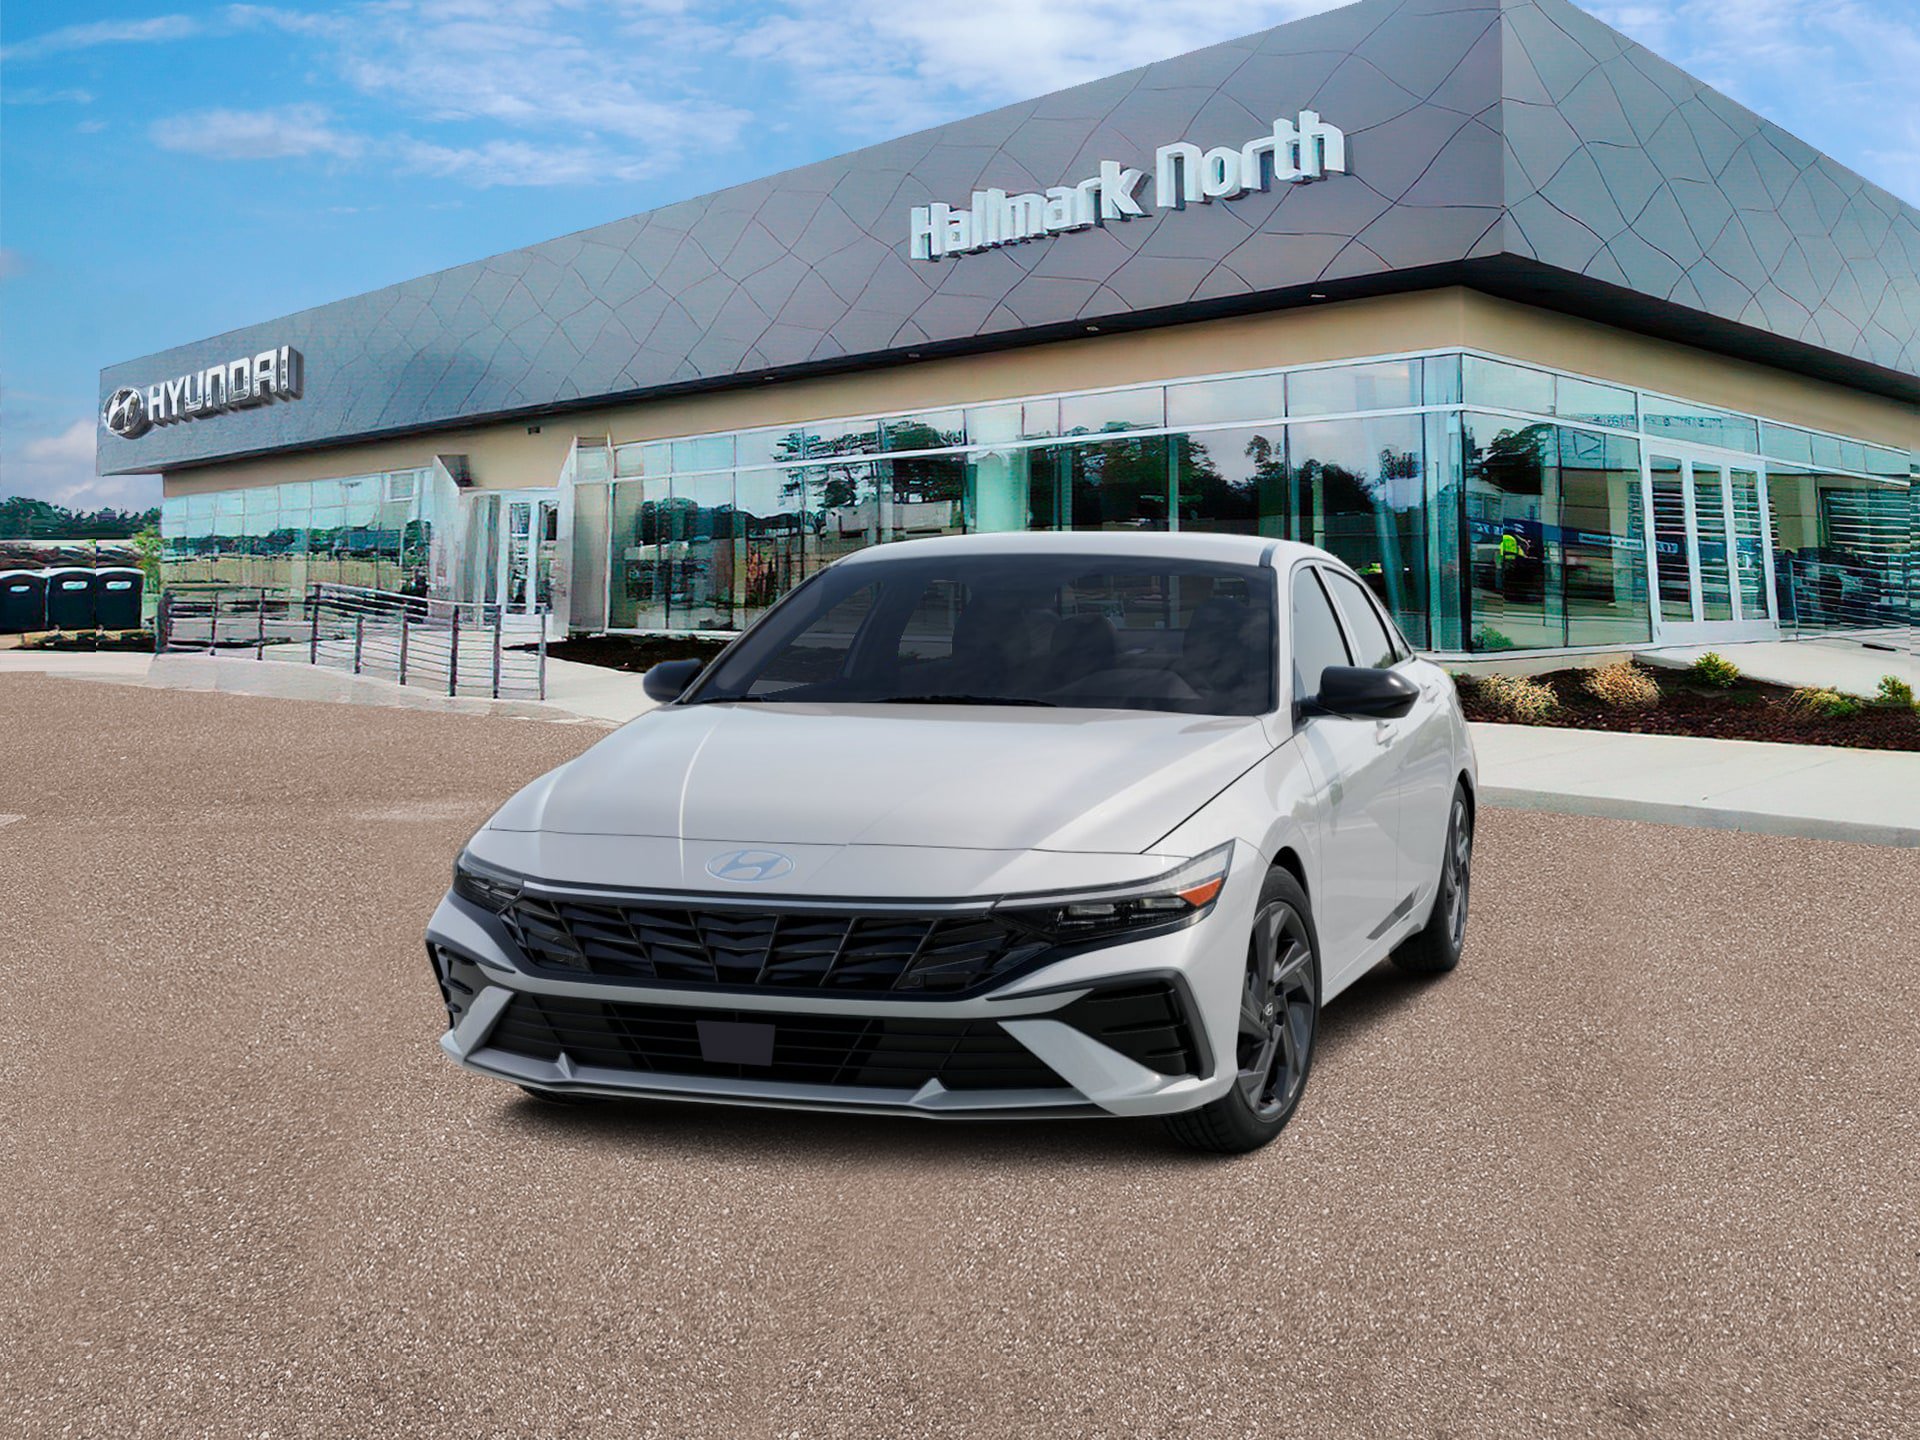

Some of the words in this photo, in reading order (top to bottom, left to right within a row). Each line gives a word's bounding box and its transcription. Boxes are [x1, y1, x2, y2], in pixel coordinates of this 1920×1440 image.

[911, 160, 1144, 261] Hallmark
[1156, 110, 1345, 209] North
[148, 345, 294, 421] HYUNDAI
